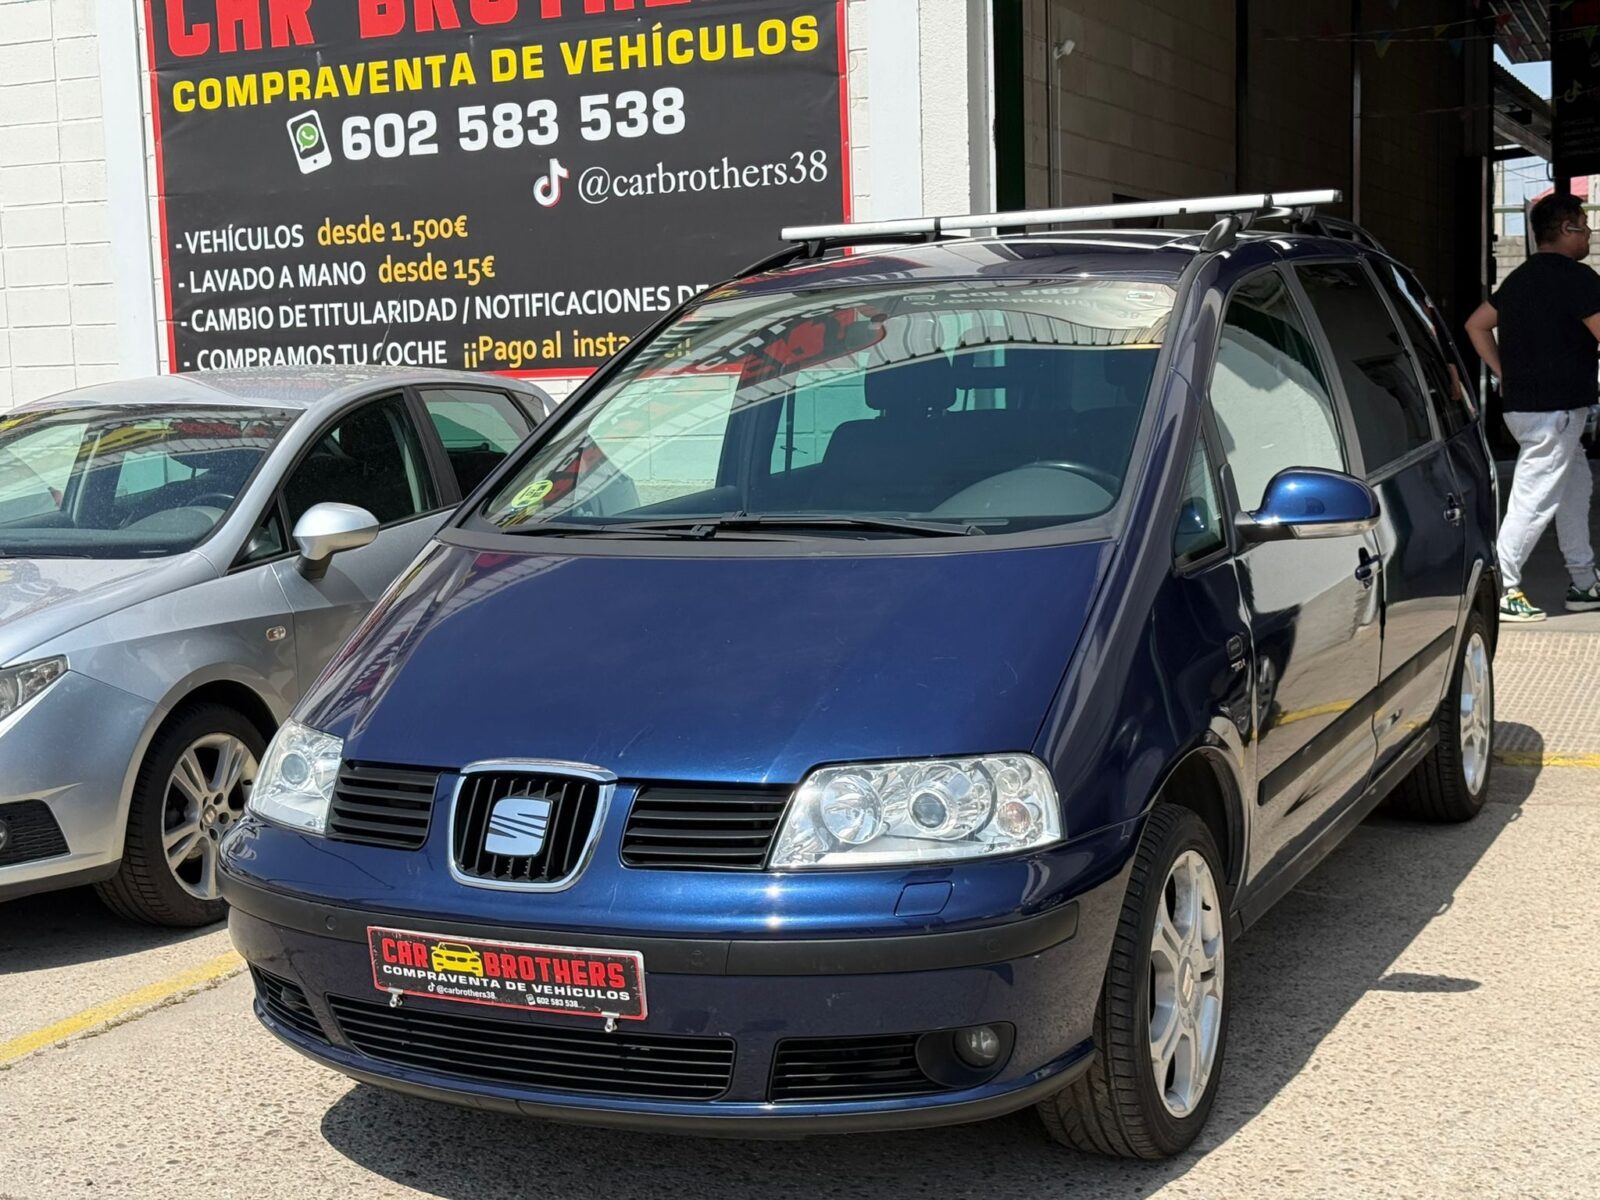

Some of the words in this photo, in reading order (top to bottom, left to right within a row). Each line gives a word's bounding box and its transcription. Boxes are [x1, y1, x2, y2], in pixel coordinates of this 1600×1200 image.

[172, 52, 476, 112] COMPRAVENTA
[491, 45, 544, 82] DE
[560, 15, 819, 75] VEHÍCULOS
[342, 110, 438, 160] 602
[458, 99, 558, 151] 583
[580, 87, 686, 141] 538
[578, 150, 828, 204] @carbrothers38
[317, 214, 385, 246] desde
[391, 215, 468, 247] 1.500€
[278, 265, 294, 289] A
[299, 261, 366, 287] MANO
[378, 252, 447, 283] desde
[453, 255, 495, 286] 15€
[279, 304, 307, 328] DE
[309, 297, 457, 327] TITULARIDAD
[475, 287, 671, 320] NOTIFICACIONES
[677, 284, 709, 305] D
[338, 343, 367, 365] TU
[373, 340, 447, 366] COCHE
[541, 331, 562, 359] al
[381, 937, 429, 968] CAR
[482, 951, 626, 988] BROTHERS
[382, 964, 501, 989] COMPRAVENTA
[505, 981, 527, 992] DE
[531, 983, 631, 1001] VEHÍCULOS
[536, 997, 549, 1005] 602
